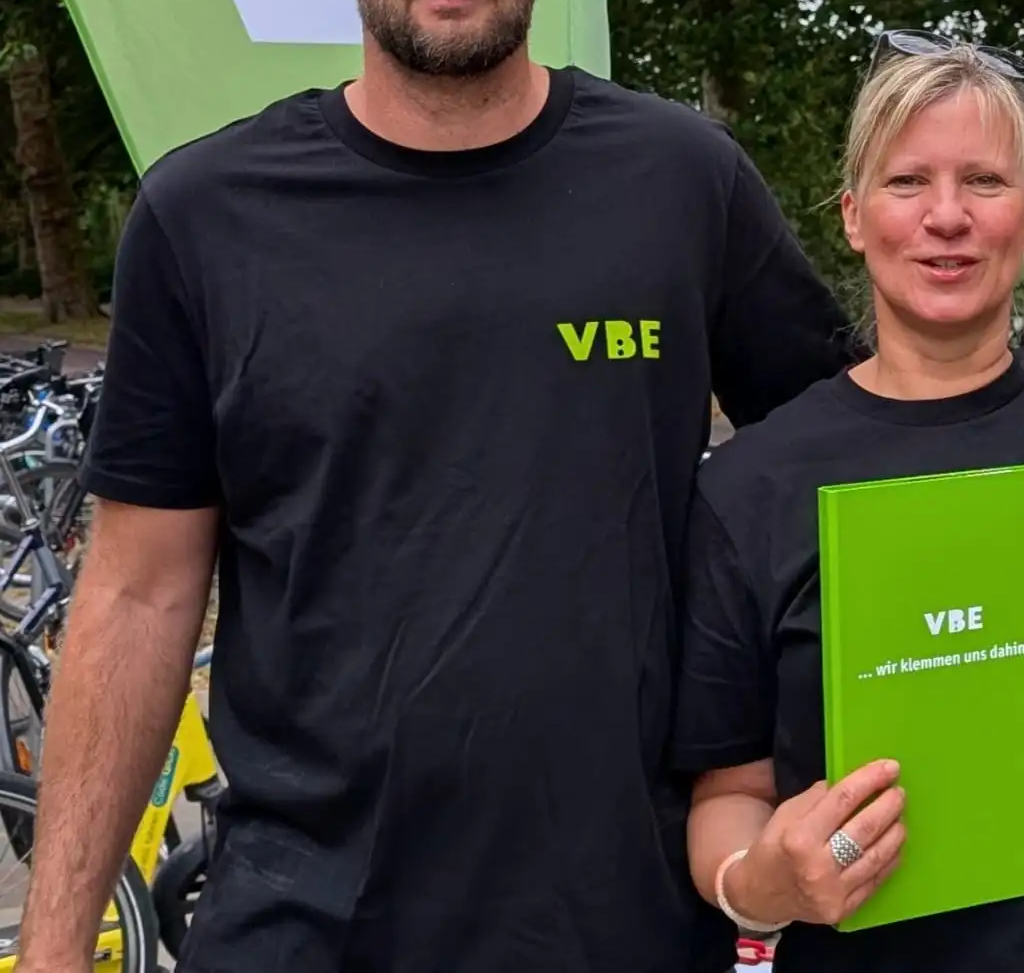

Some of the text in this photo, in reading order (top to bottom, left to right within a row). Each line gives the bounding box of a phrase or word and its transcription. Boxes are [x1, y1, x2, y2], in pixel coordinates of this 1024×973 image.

[557, 319, 661, 361] VBE
[924, 606, 983, 635] VBE
[876, 660, 897, 676] wir
[900, 653, 960, 673] klemmen
[964, 648, 987, 663] uns
